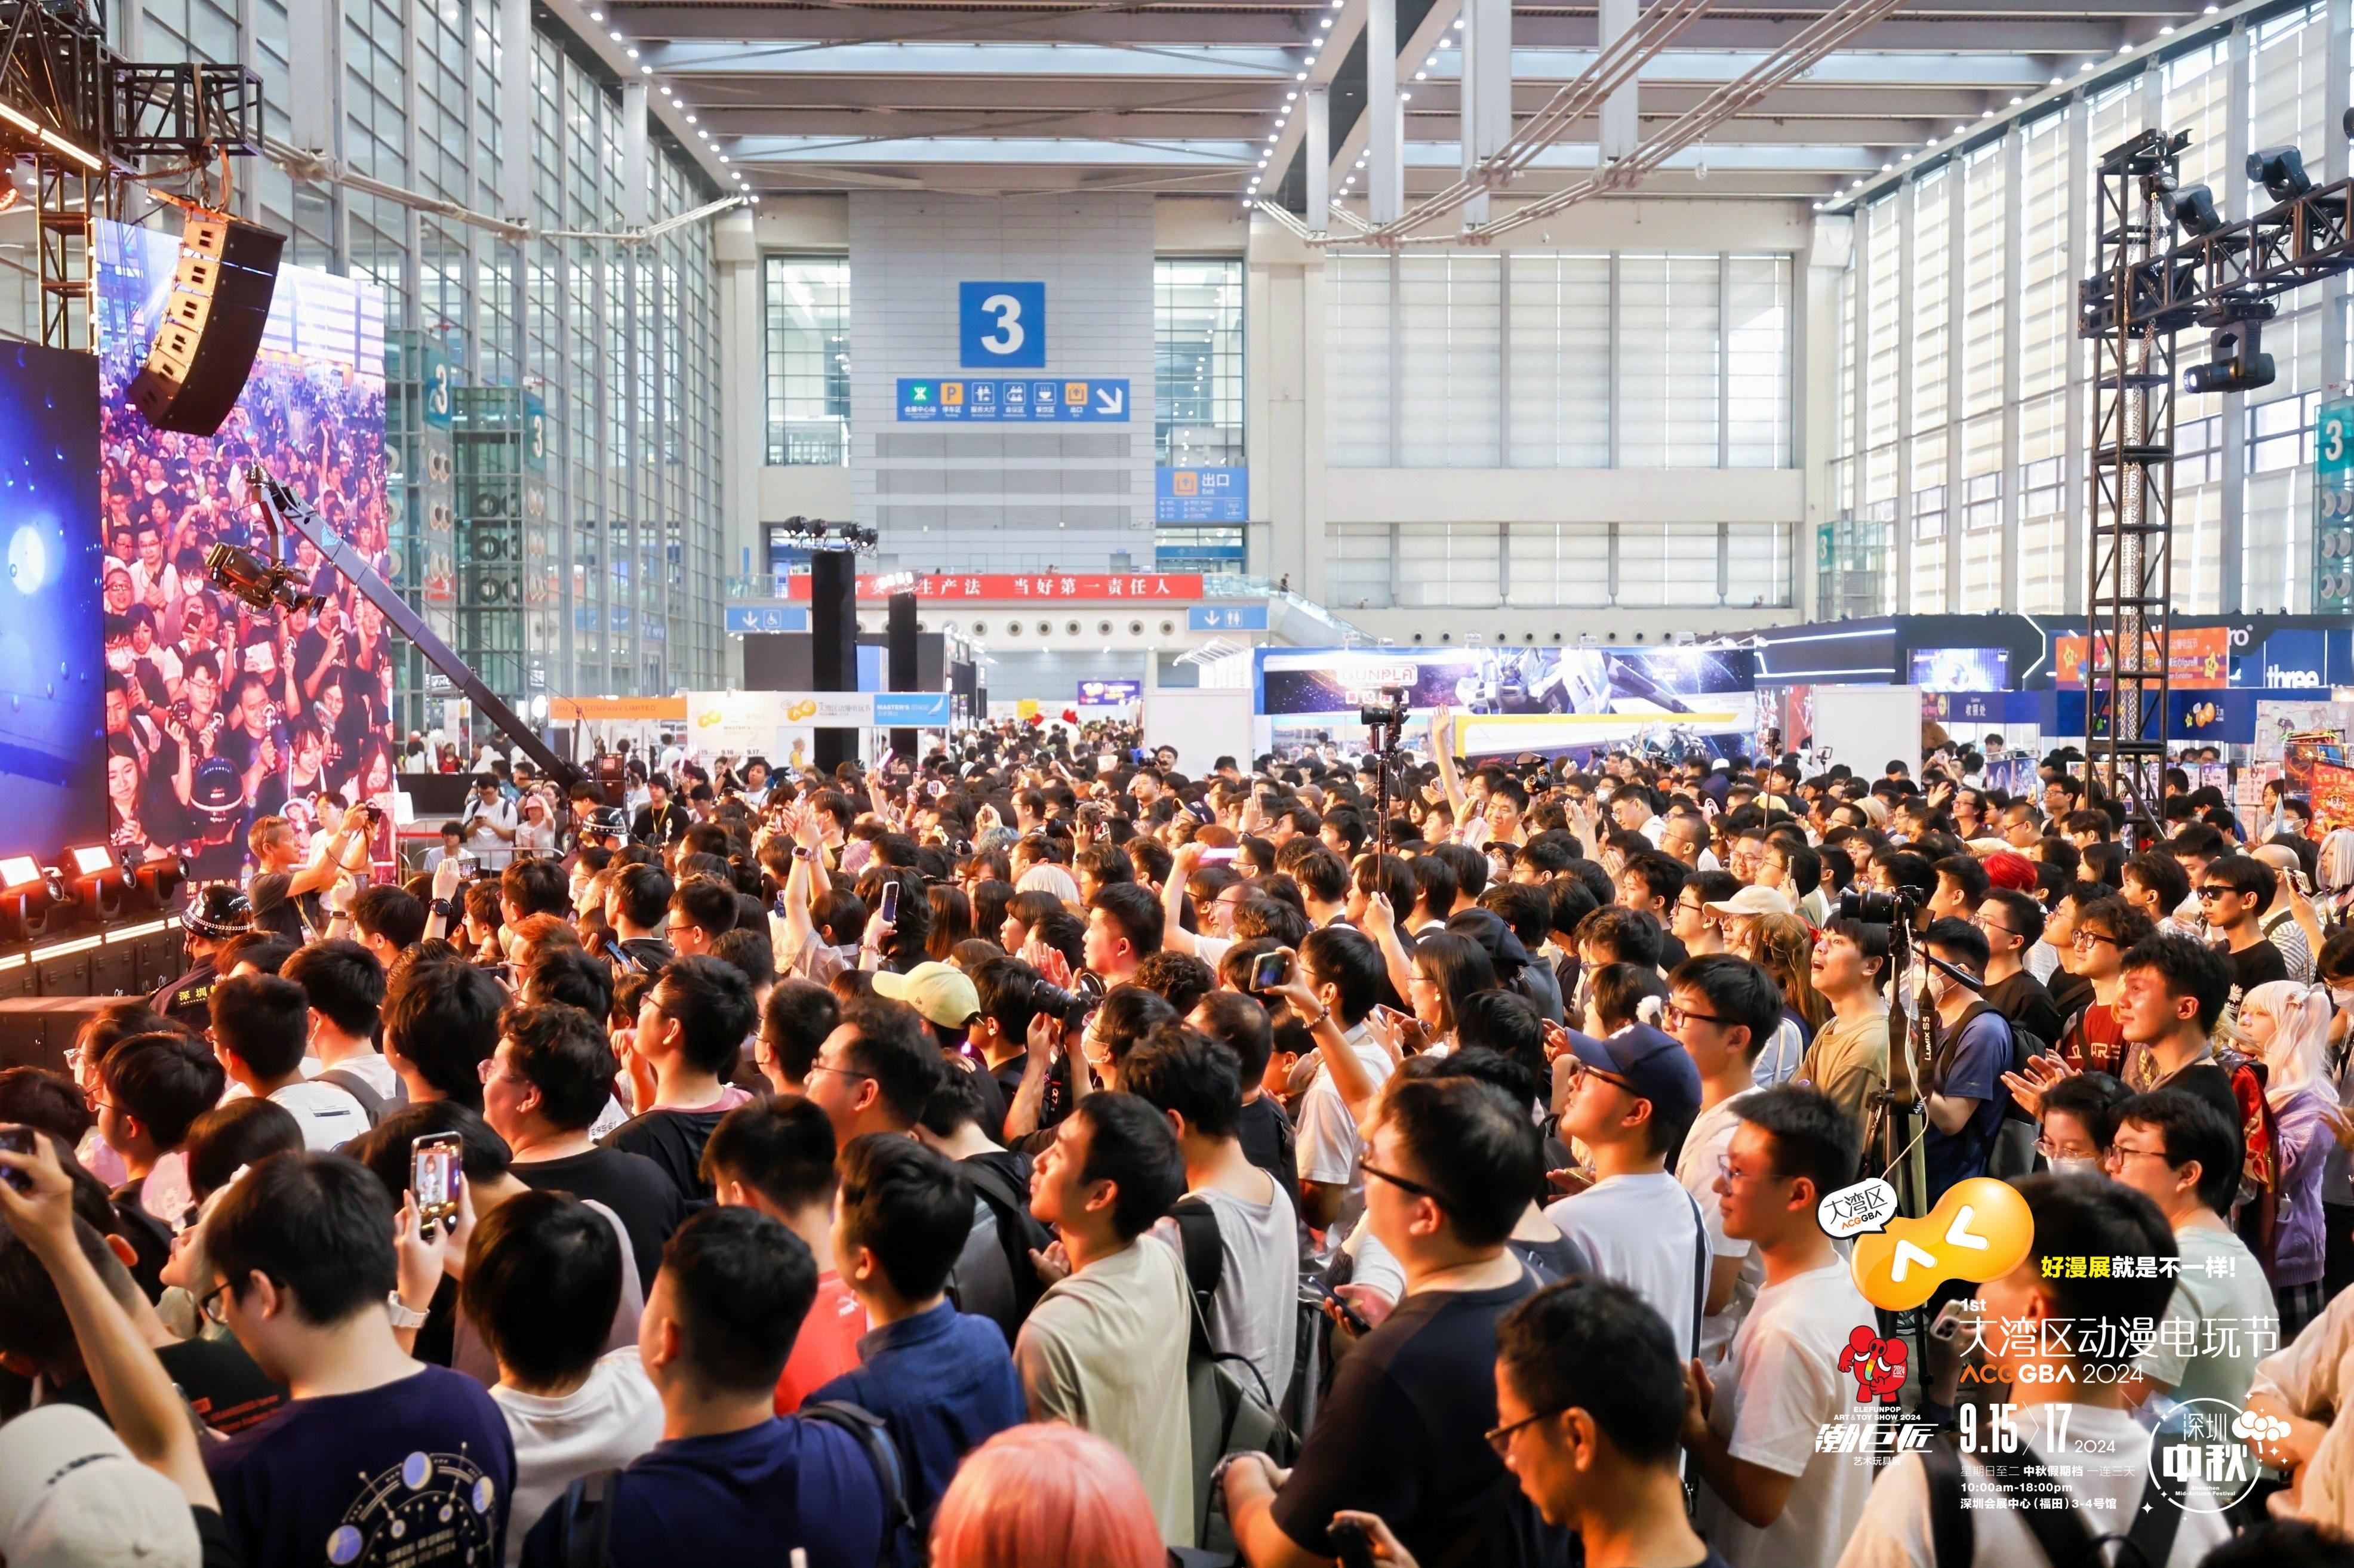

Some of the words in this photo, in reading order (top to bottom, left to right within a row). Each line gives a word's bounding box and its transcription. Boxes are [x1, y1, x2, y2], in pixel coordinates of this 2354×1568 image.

[980, 294, 1024, 354] 3
[435, 363, 448, 414] 3
[533, 415, 542, 458] 3
[2325, 420, 2343, 461] 3
[1202, 473, 1230, 486] 出口
[1014, 578, 1170, 595] 当好第一责任人
[2266, 664, 2319, 688] three
[1965, 704, 1986, 716] 收银处
[1923, 1016, 1930, 1030] S5
